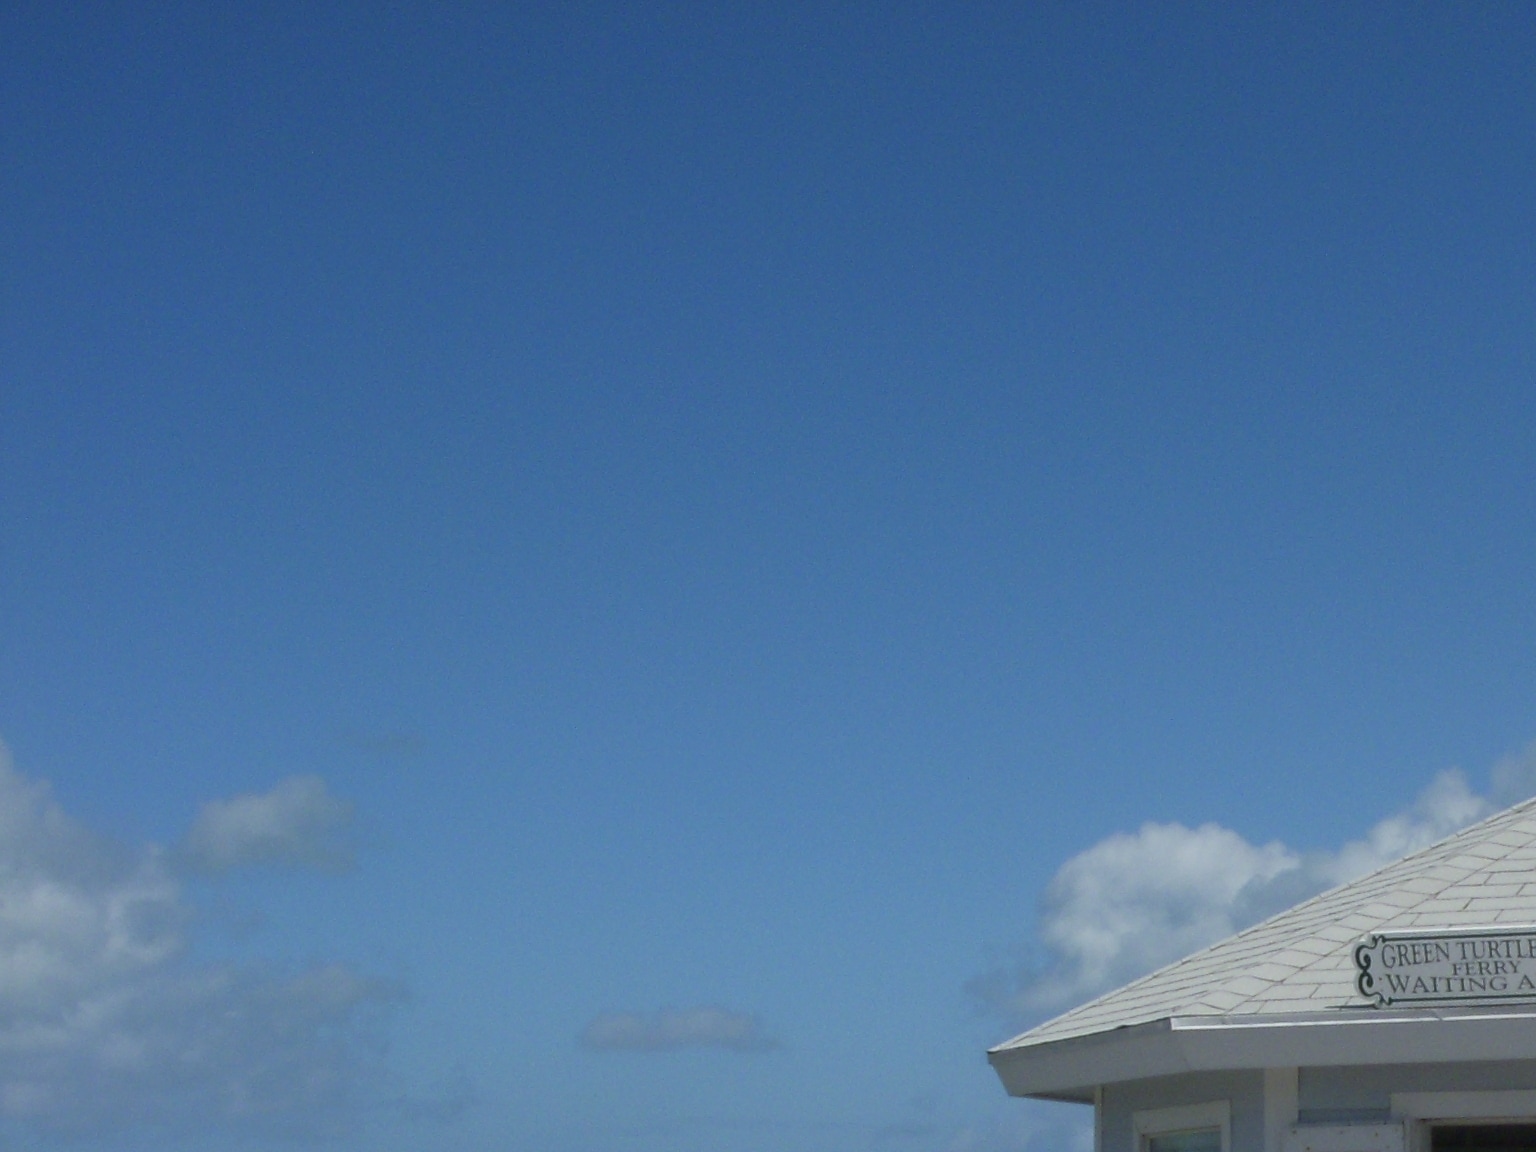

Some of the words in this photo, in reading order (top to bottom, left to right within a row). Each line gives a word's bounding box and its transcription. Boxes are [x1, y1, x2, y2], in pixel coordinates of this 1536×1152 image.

[1381, 941, 1449, 969] GREEN
[1452, 961, 1522, 976] FERRY
[1386, 973, 1507, 994] WAITING
